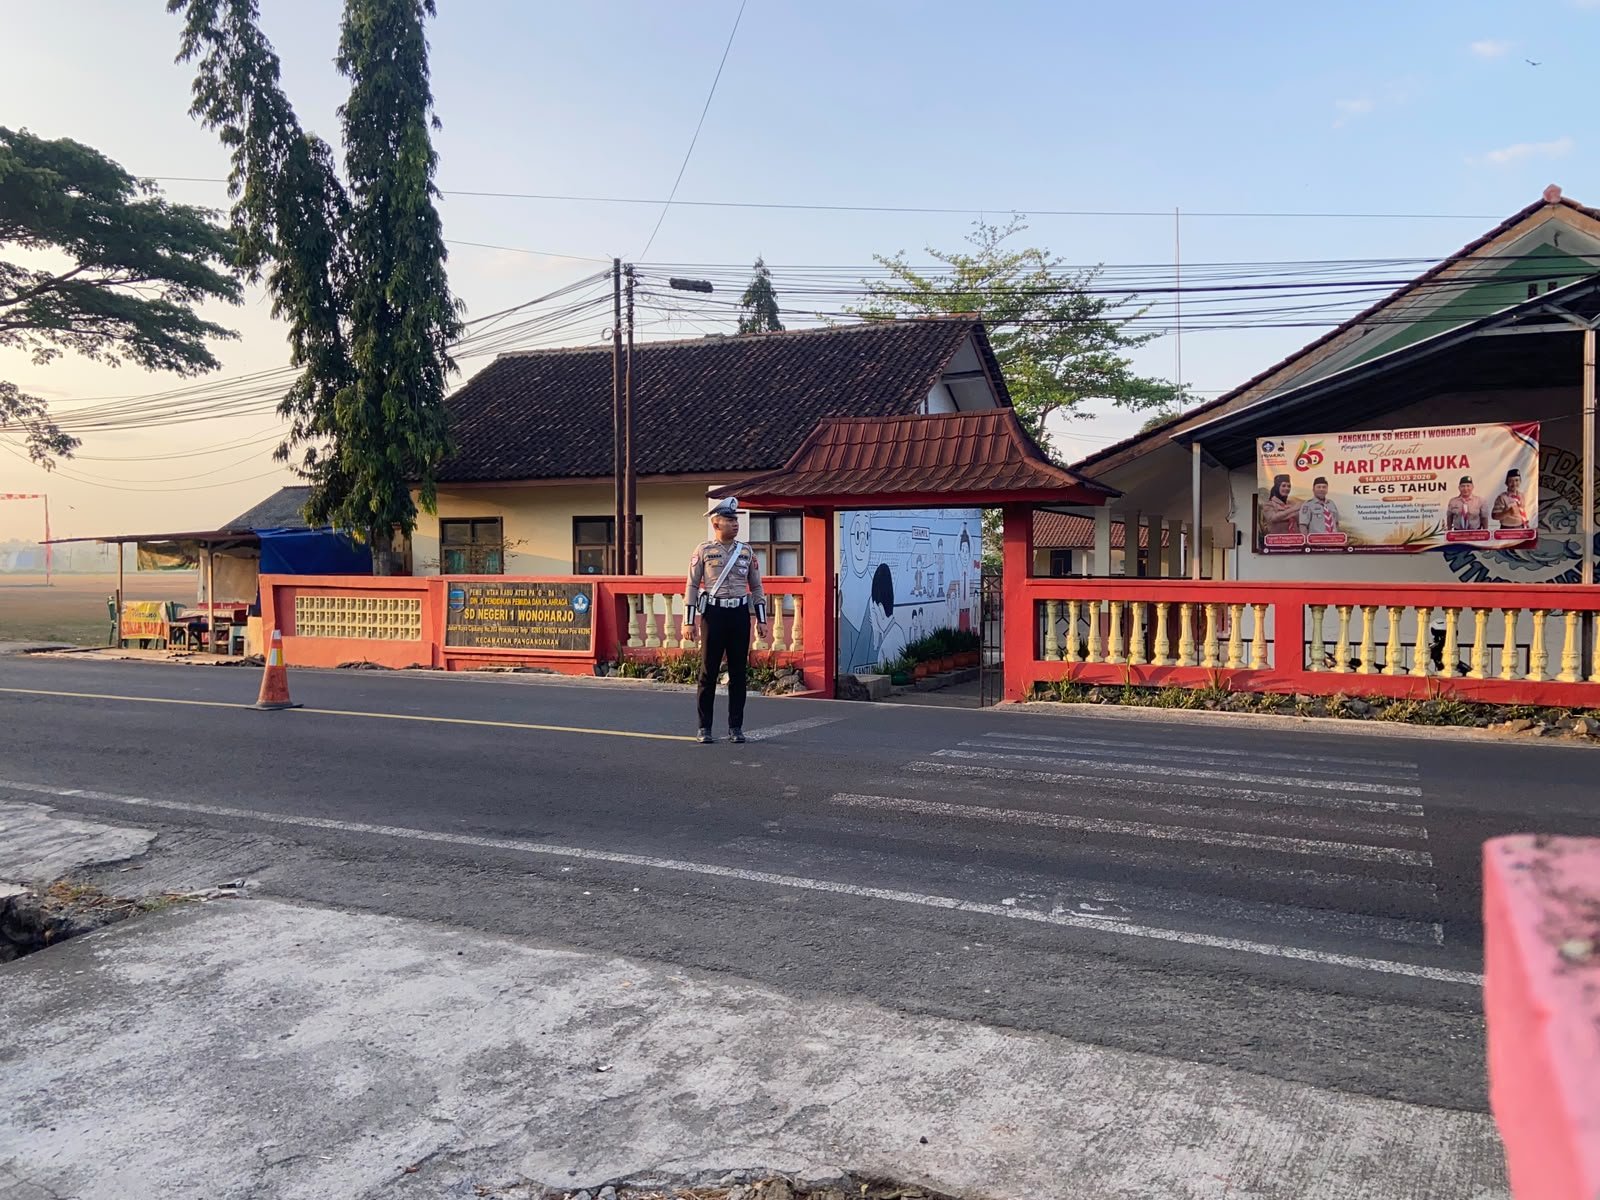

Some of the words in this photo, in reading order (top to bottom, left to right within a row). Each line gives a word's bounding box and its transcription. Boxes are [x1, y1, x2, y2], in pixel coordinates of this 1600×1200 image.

[1338, 433, 1380, 443] PANGKALAN
[1382, 432, 1392, 441] SD
[1394, 431, 1420, 440] NEGERI
[1428, 427, 1477, 438] WONOHARJO
[1368, 443, 1423, 460] Selamat
[1334, 459, 1374, 474] HARI
[1380, 454, 1470, 473] PRAMUKA
[1353, 484, 1395, 495] KE-65
[1400, 482, 1447, 493] TAHUN
[542, 598, 569, 607] OLAHRAGA
[464, 608, 475, 619] SD
[478, 609, 508, 621] NEGERI
[509, 609, 514, 621] 1
[518, 610, 574, 622] WONOHARJO
[476, 637, 511, 645] KECAMATAN
[513, 638, 559, 646] PANGANDARAN
